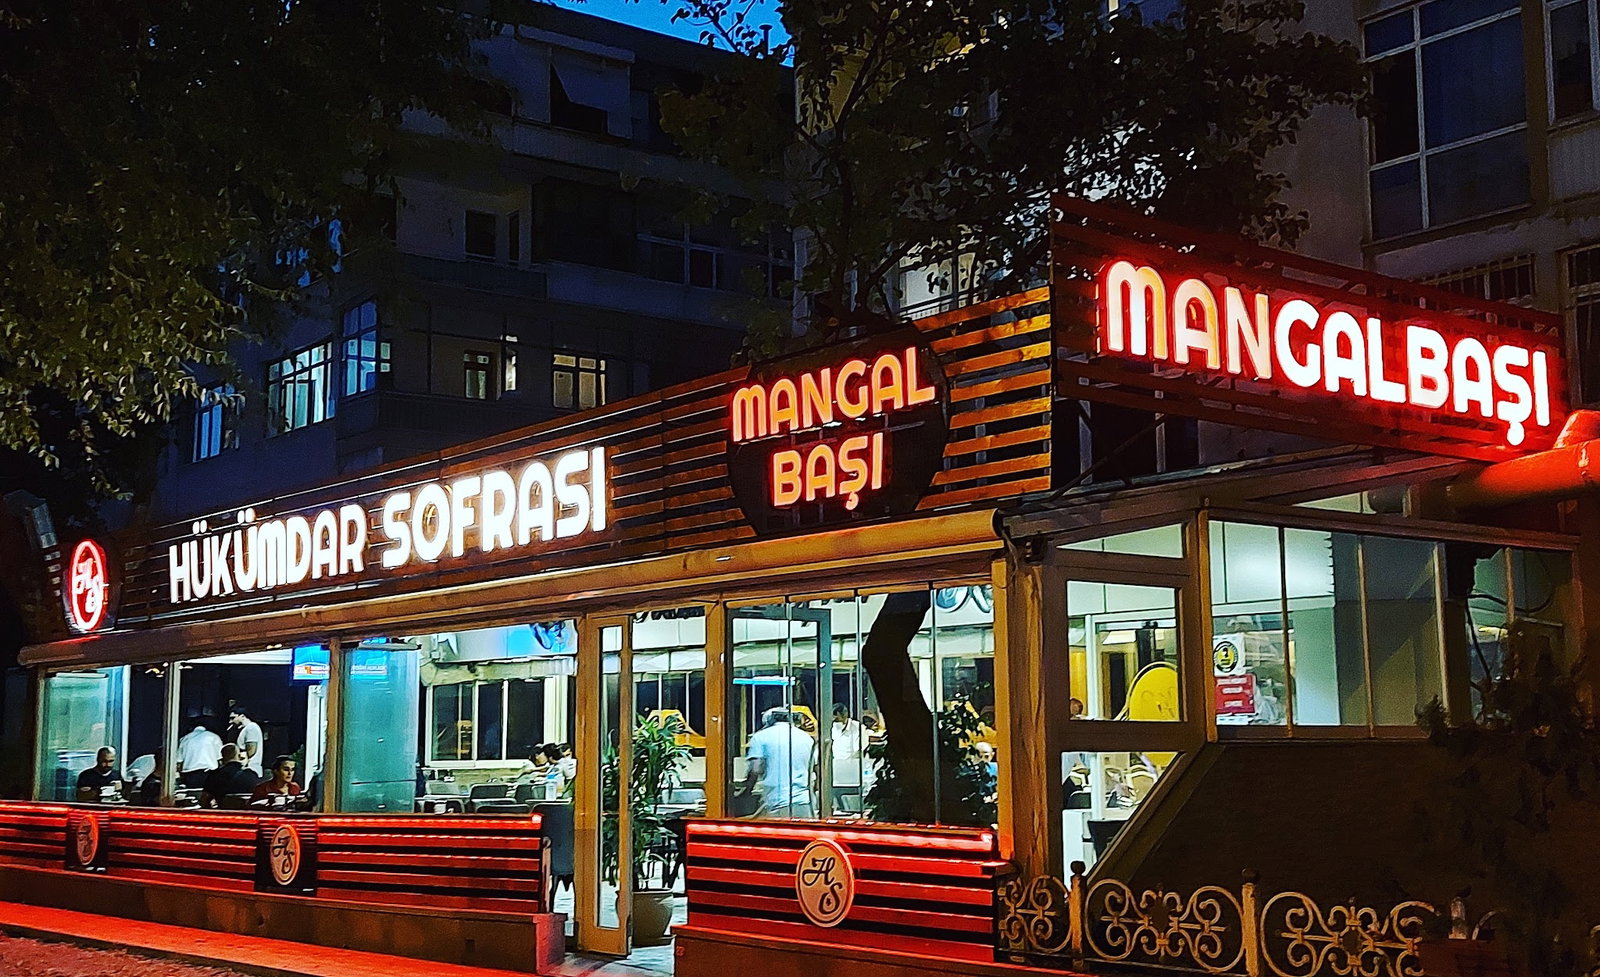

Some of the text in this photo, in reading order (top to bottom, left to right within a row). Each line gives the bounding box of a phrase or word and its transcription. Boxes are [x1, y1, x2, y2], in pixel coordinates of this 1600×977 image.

[732, 346, 936, 442] MANGAL
[1106, 261, 1550, 446] MANGALBAŞI
[169, 446, 606, 604] HÜKÜMDAR SOFRASI
[773, 432, 884, 511] BAŞI
